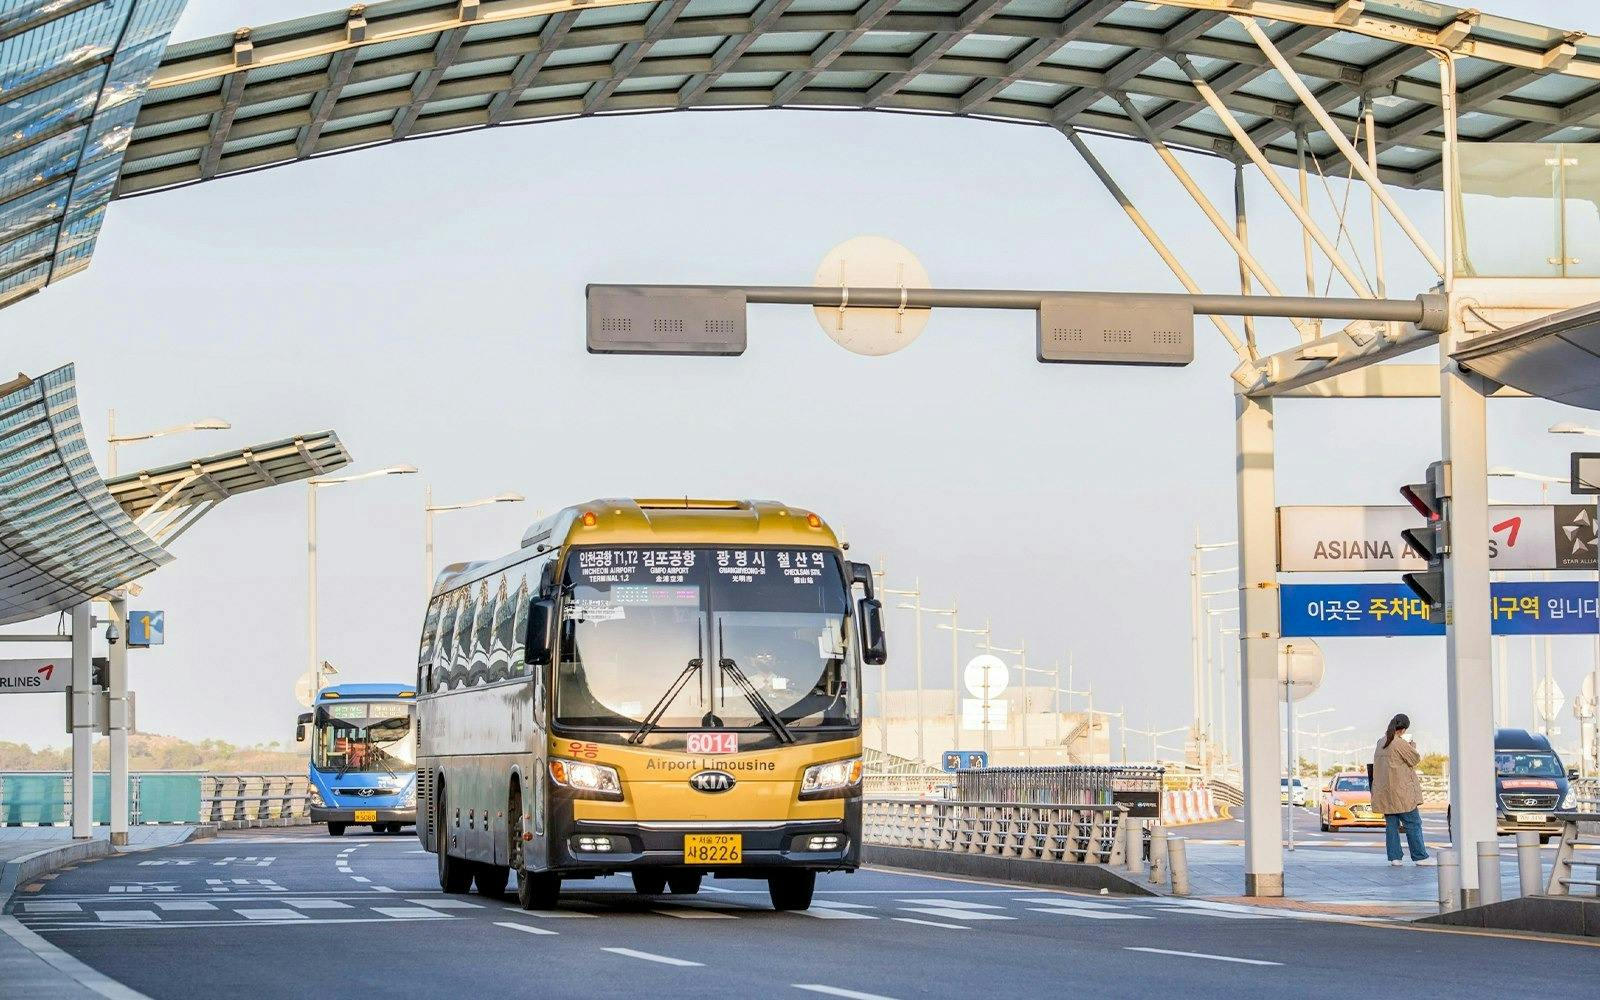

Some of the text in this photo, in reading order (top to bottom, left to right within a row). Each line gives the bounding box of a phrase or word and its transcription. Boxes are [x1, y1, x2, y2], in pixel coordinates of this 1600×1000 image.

[1313, 540, 1394, 559] ASIANA
[579, 550, 638, 568] 인천공항 T1,T2
[643, 550, 696, 567] 김포공항
[582, 566, 636, 575] INCHEON AIRPORT
[589, 575, 619, 583] TERMINAL
[1307, 600, 1363, 621] 이곳은
[1547, 598, 1599, 618] 입니다
[140, 615, 151, 641] 1
[568, 741, 598, 759] 우등
[687, 733, 738, 753] 6014
[646, 758, 776, 772] Airport Limousine
[698, 774, 729, 790] KIA
[715, 836, 728, 844] 70
